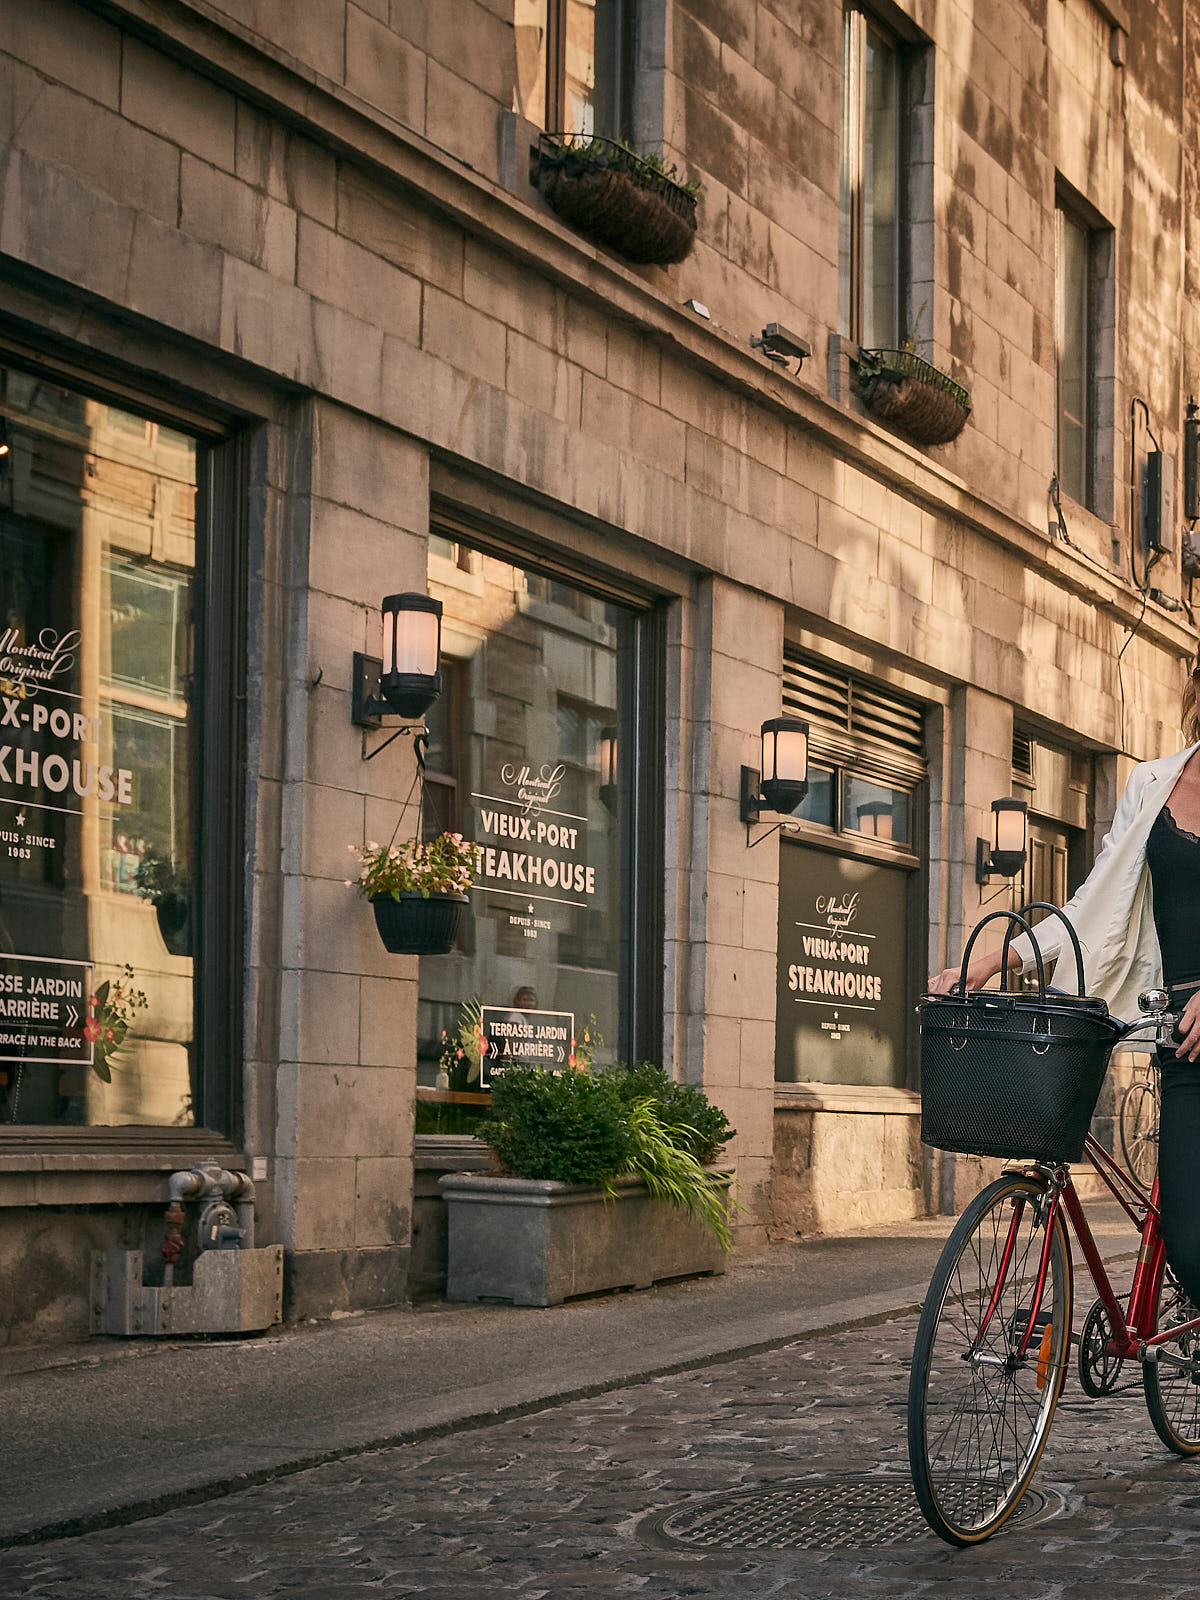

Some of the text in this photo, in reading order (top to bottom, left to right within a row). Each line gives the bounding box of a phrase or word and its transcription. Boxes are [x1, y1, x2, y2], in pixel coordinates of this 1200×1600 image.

[0, 653, 75, 697] Original
[0, 830, 56, 849] UIS SINCE
[481, 810, 577, 850] VIEUX-PORT
[8, 846, 31, 859] 1983
[474, 846, 595, 894] TEAKHOUSE
[803, 936, 869, 965] VIEUX-PORT
[27, 977, 81, 998] JARDIN
[788, 964, 882, 1001] STEAKHOUSE
[489, 1022, 567, 1040] TERRASSE JARDIN
[28, 1035, 38, 1045] IN
[40, 1036, 57, 1047] THE
[58, 1037, 81, 1049] BACK
[503, 1039, 511, 1055] À
